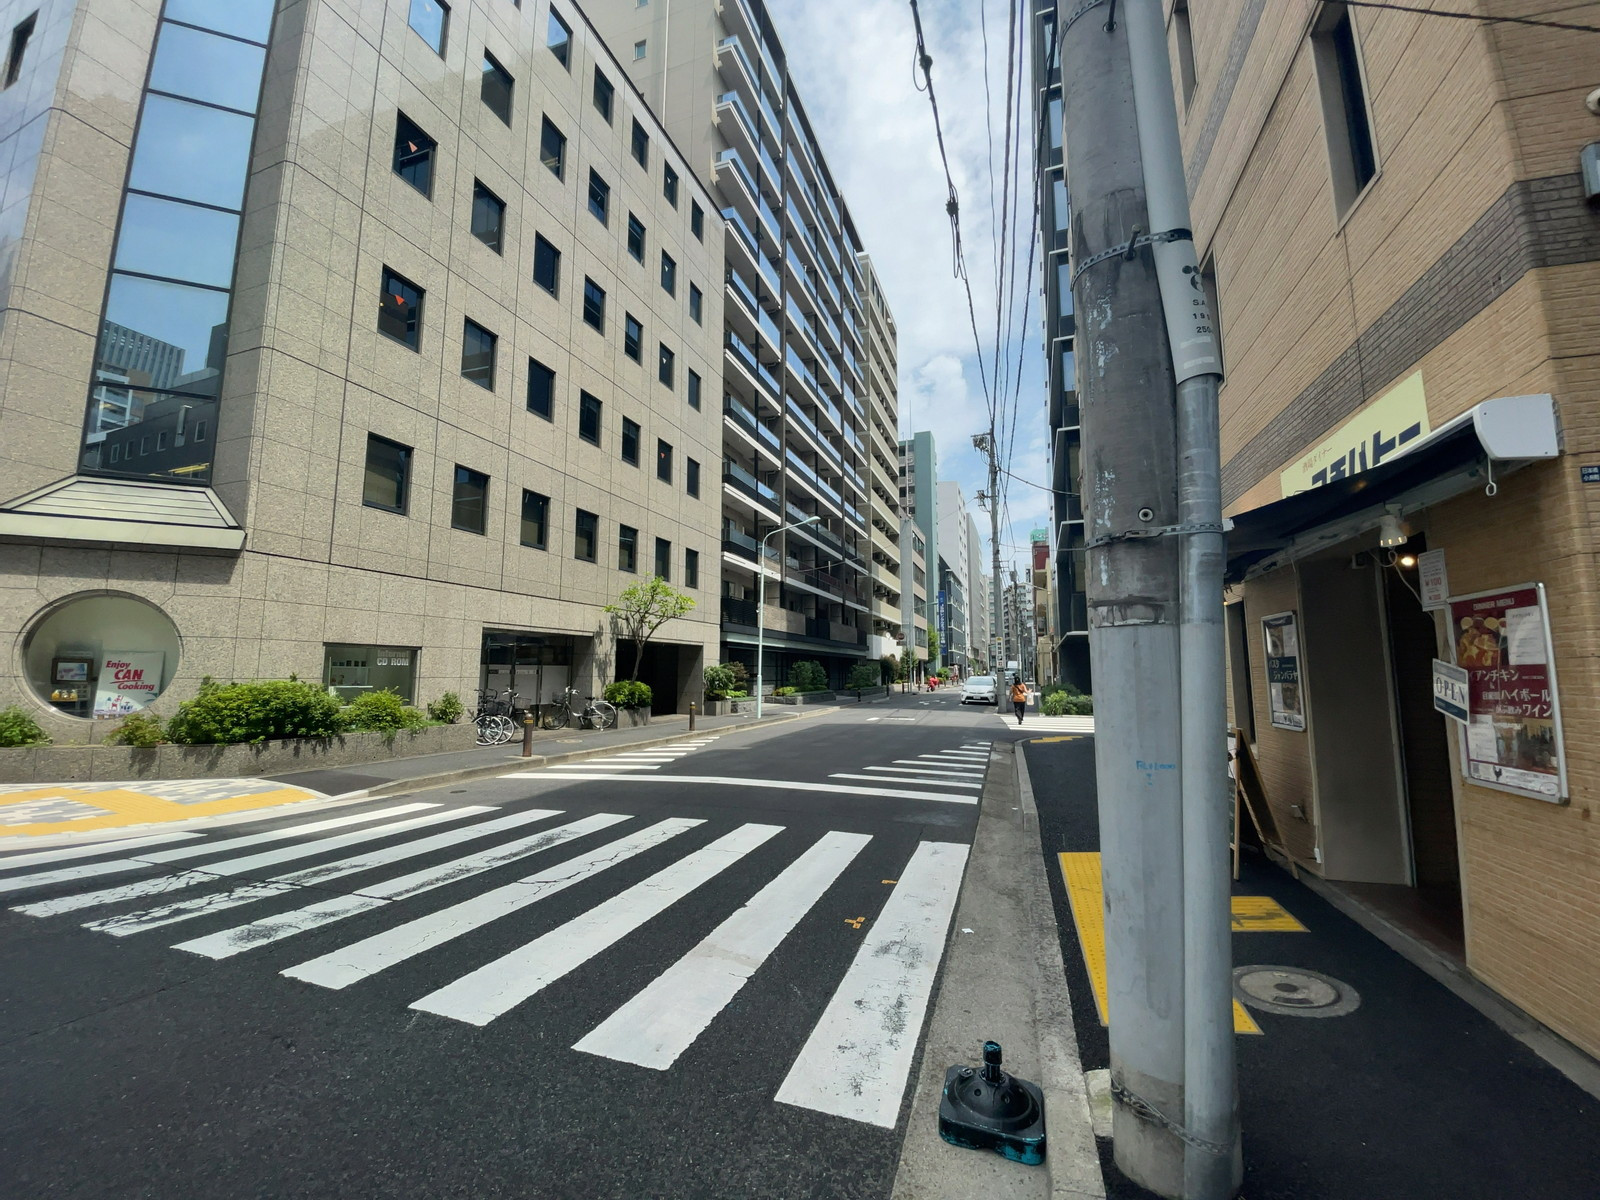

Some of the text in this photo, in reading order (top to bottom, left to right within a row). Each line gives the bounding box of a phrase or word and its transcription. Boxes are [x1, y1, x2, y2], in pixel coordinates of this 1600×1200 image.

[1496, 597, 1515, 607] MENU
[106, 660, 131, 669] Enjoy
[376, 657, 409, 666] CD ROM
[114, 669, 144, 680] CAN
[117, 682, 155, 691] Cooking
[1435, 676, 1466, 705] OPEN
